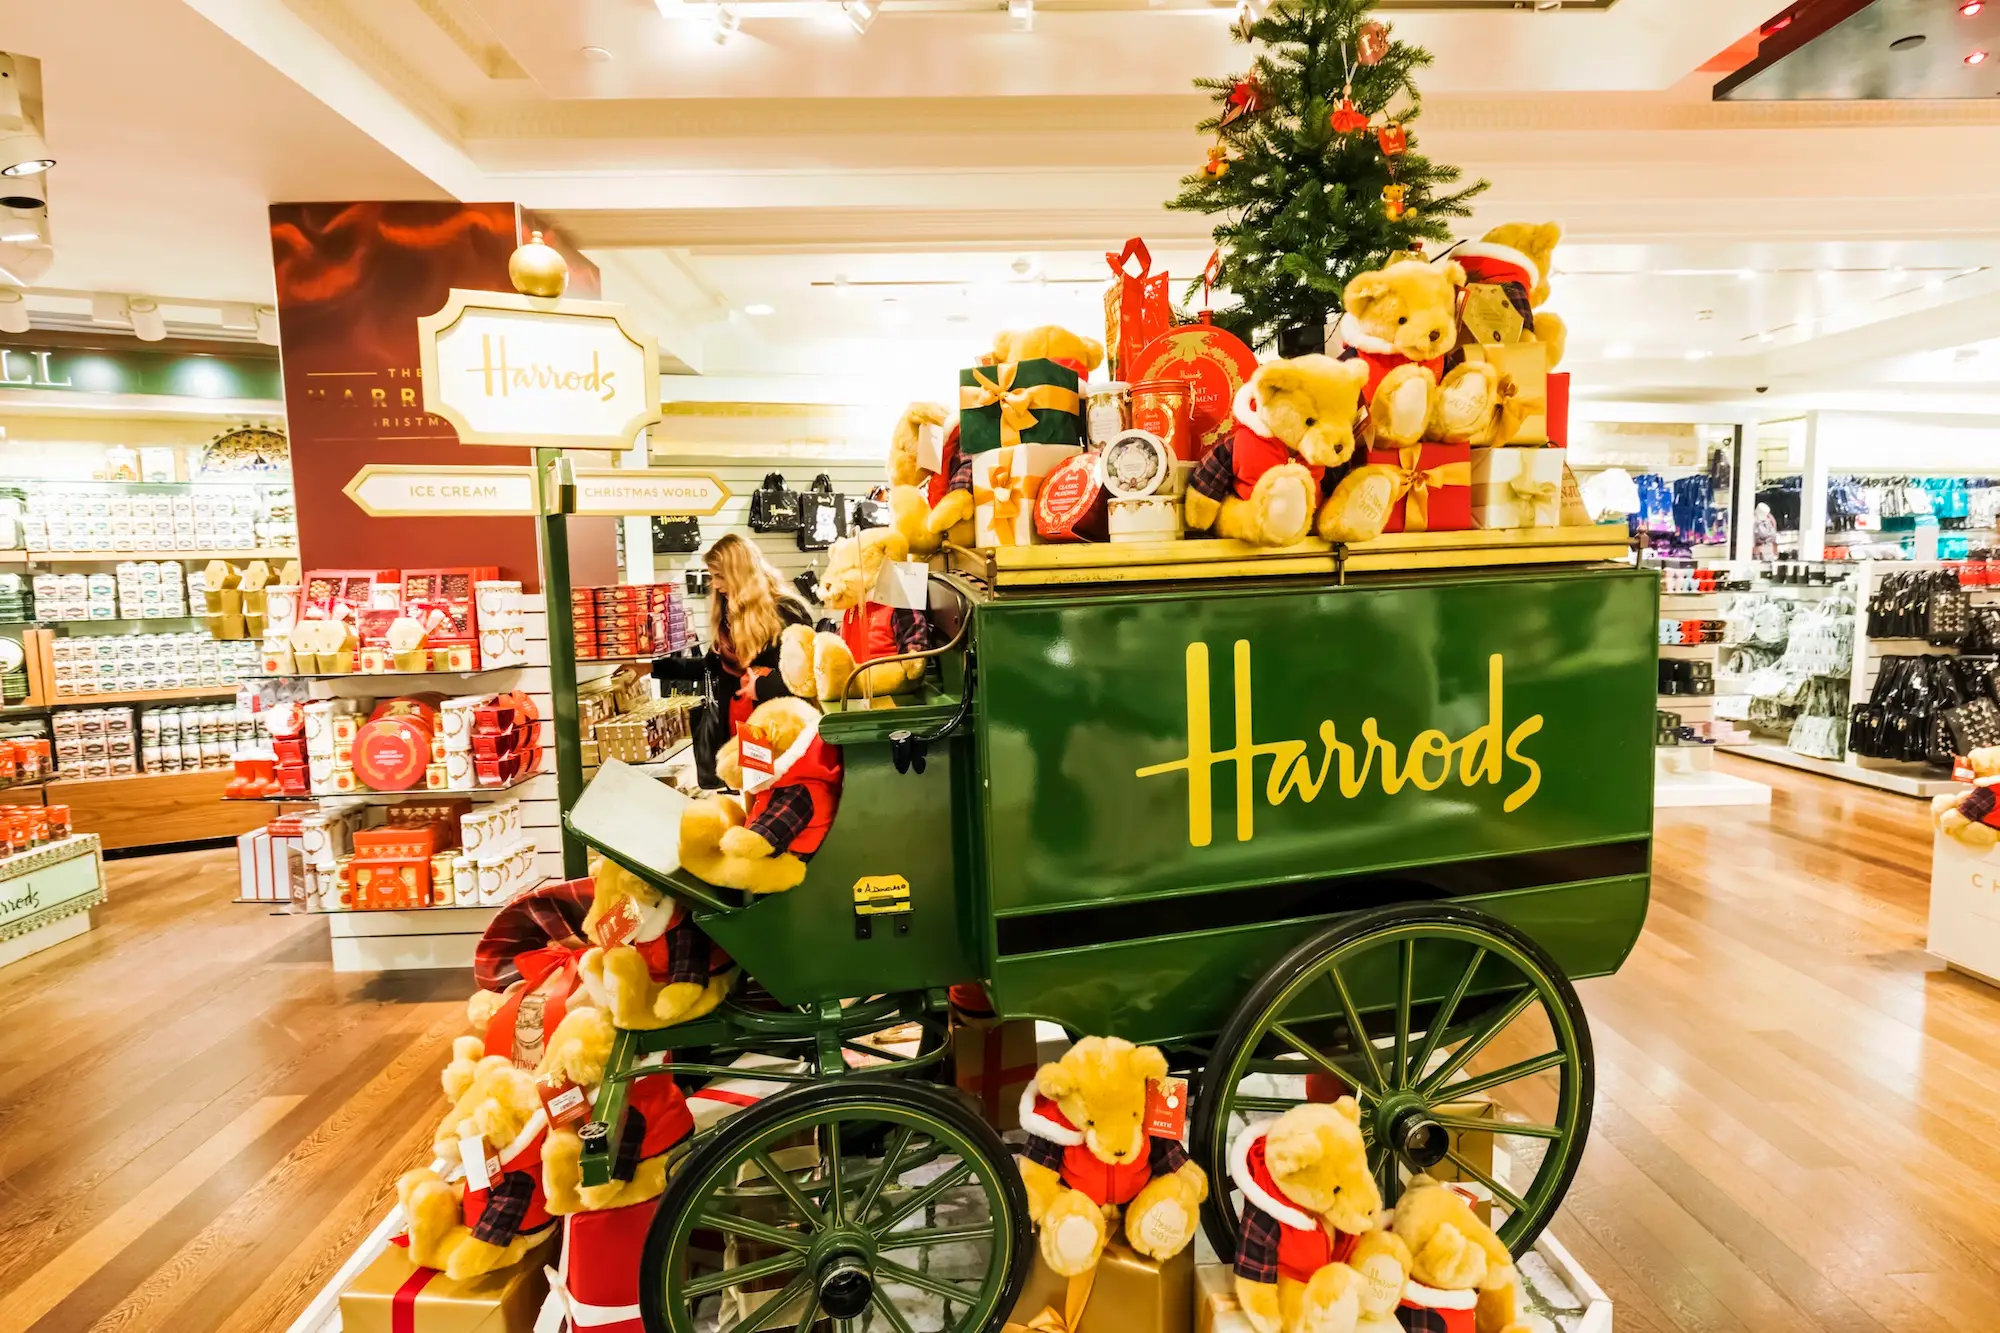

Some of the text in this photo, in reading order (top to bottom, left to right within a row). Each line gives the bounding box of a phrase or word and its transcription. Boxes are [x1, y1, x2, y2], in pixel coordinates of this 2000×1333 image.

[466, 334, 615, 402] Harrods
[409, 485, 497, 498] ICE CREAM
[584, 487, 708, 498] CHRISTMAS WORLD
[1135, 639, 1544, 848] Harrods
[0, 882, 40, 915] rrods
